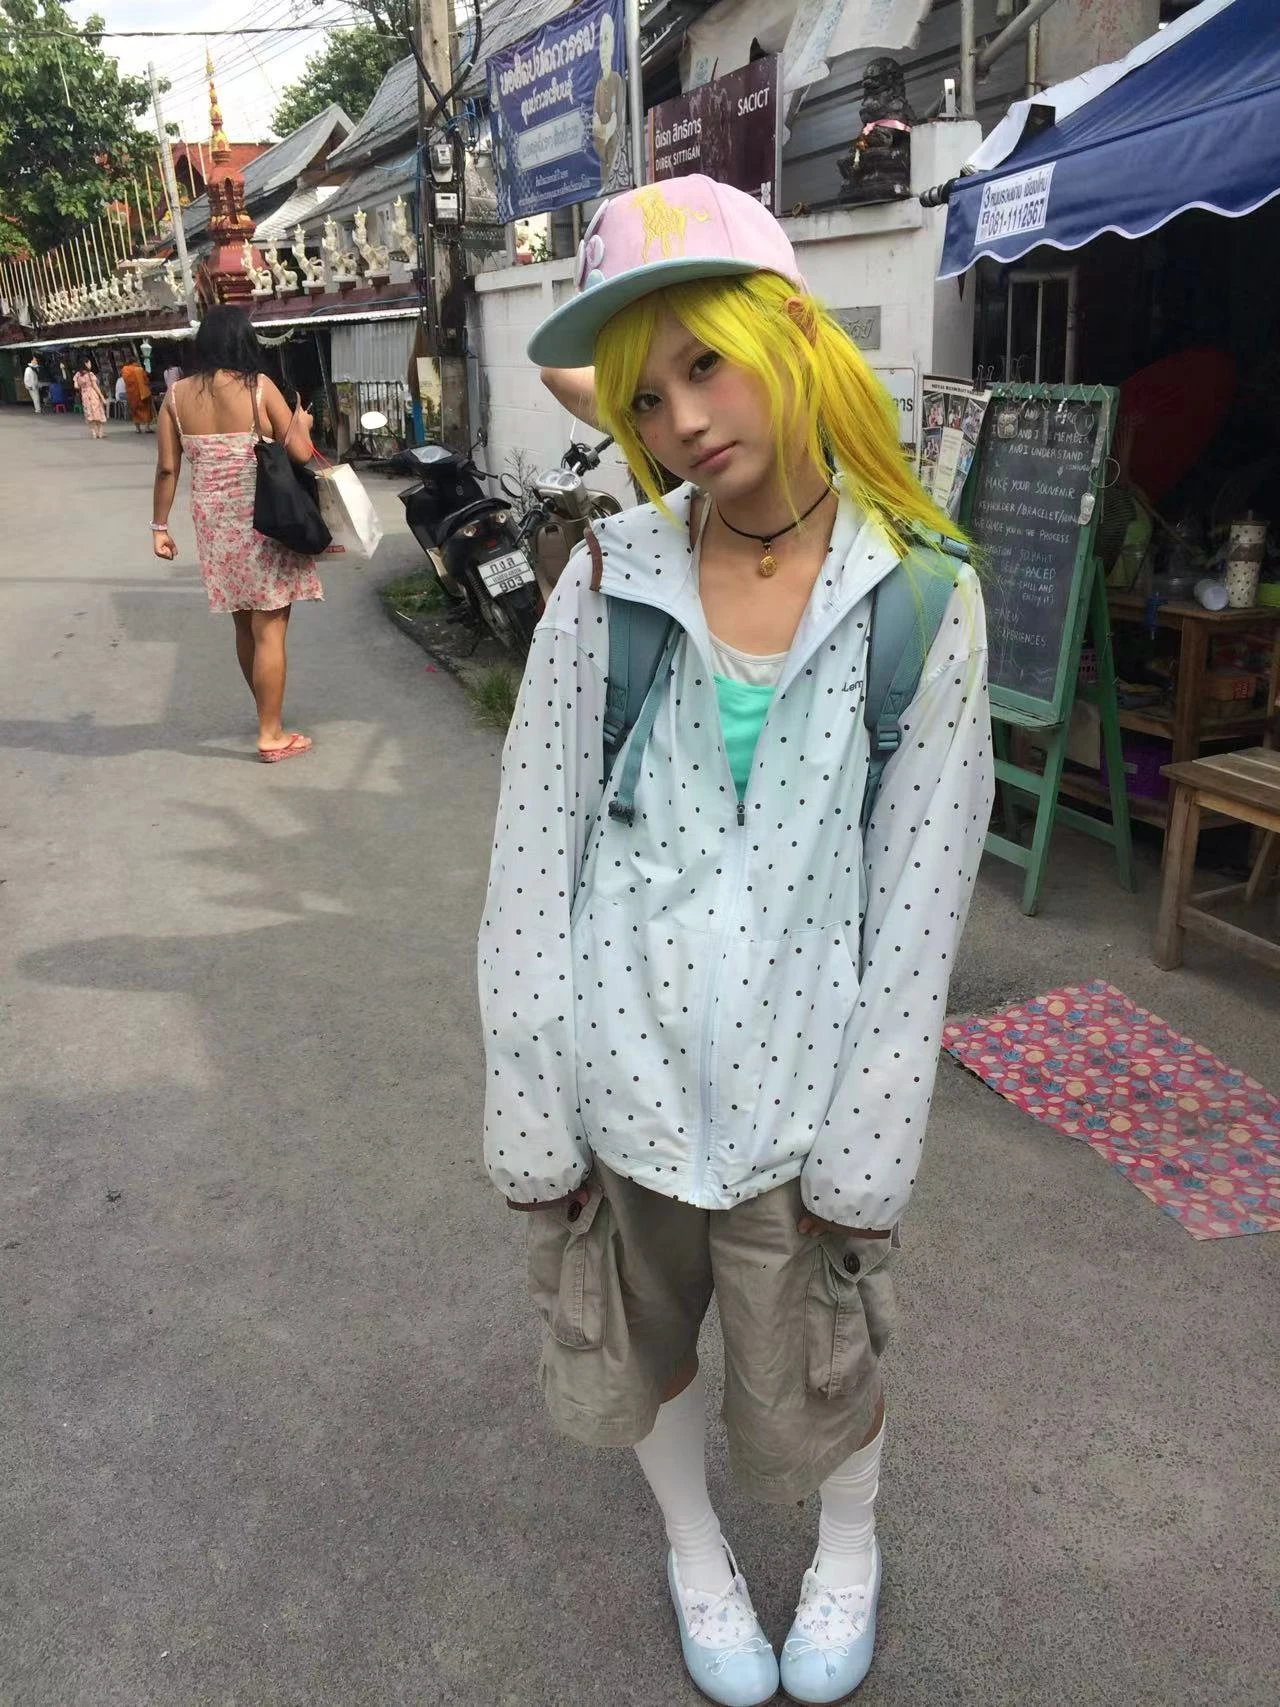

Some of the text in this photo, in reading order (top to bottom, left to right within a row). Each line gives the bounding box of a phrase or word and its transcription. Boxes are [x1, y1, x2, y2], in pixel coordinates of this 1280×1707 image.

[737, 87, 770, 116] SACICT
[655, 145, 701, 171] DIREK SITTIGAN
[1031, 447, 1084, 461] UNDERSTAND
[985, 476, 1076, 499] MAKE YOUR SOUVENIR
